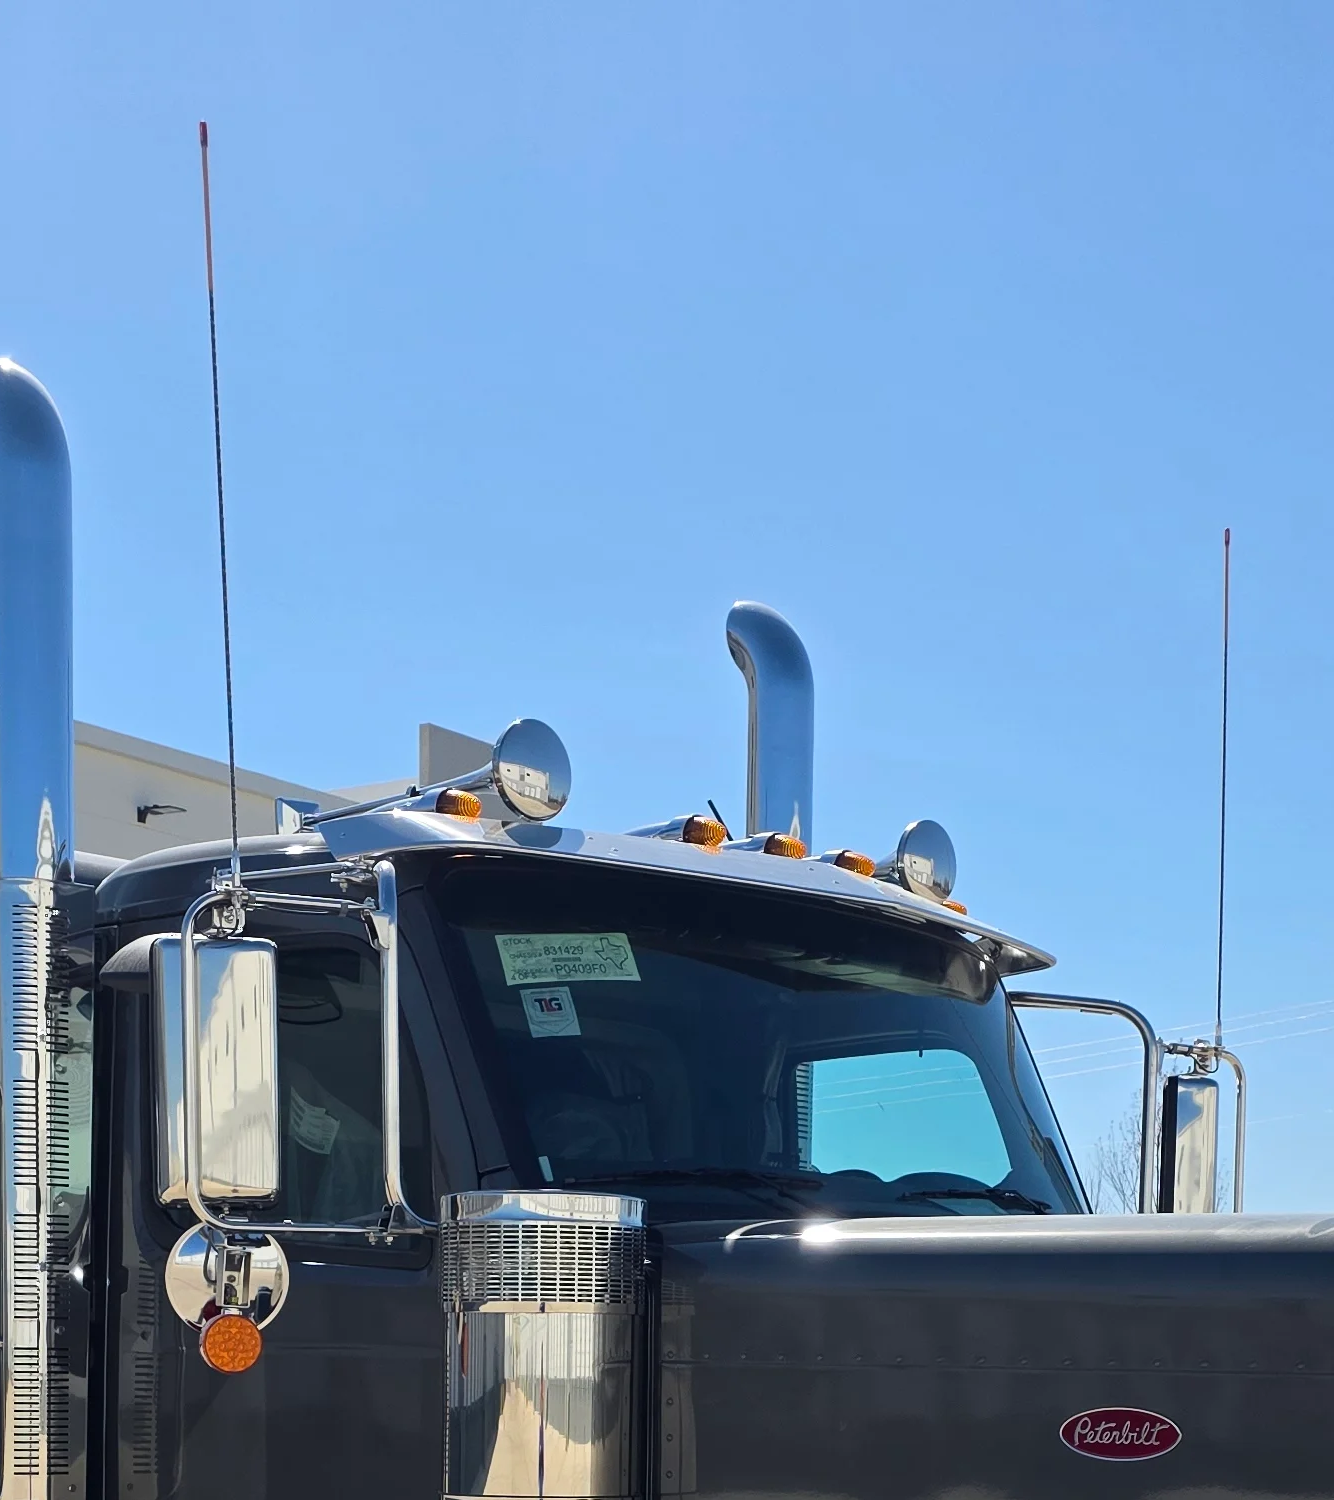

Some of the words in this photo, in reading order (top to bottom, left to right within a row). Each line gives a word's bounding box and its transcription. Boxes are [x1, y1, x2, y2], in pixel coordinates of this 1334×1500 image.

[502, 938, 532, 946] STOCK
[543, 946, 583, 955] 831429
[534, 997, 563, 1012] TLG
[1073, 1416, 1170, 1446] Peterbilt
